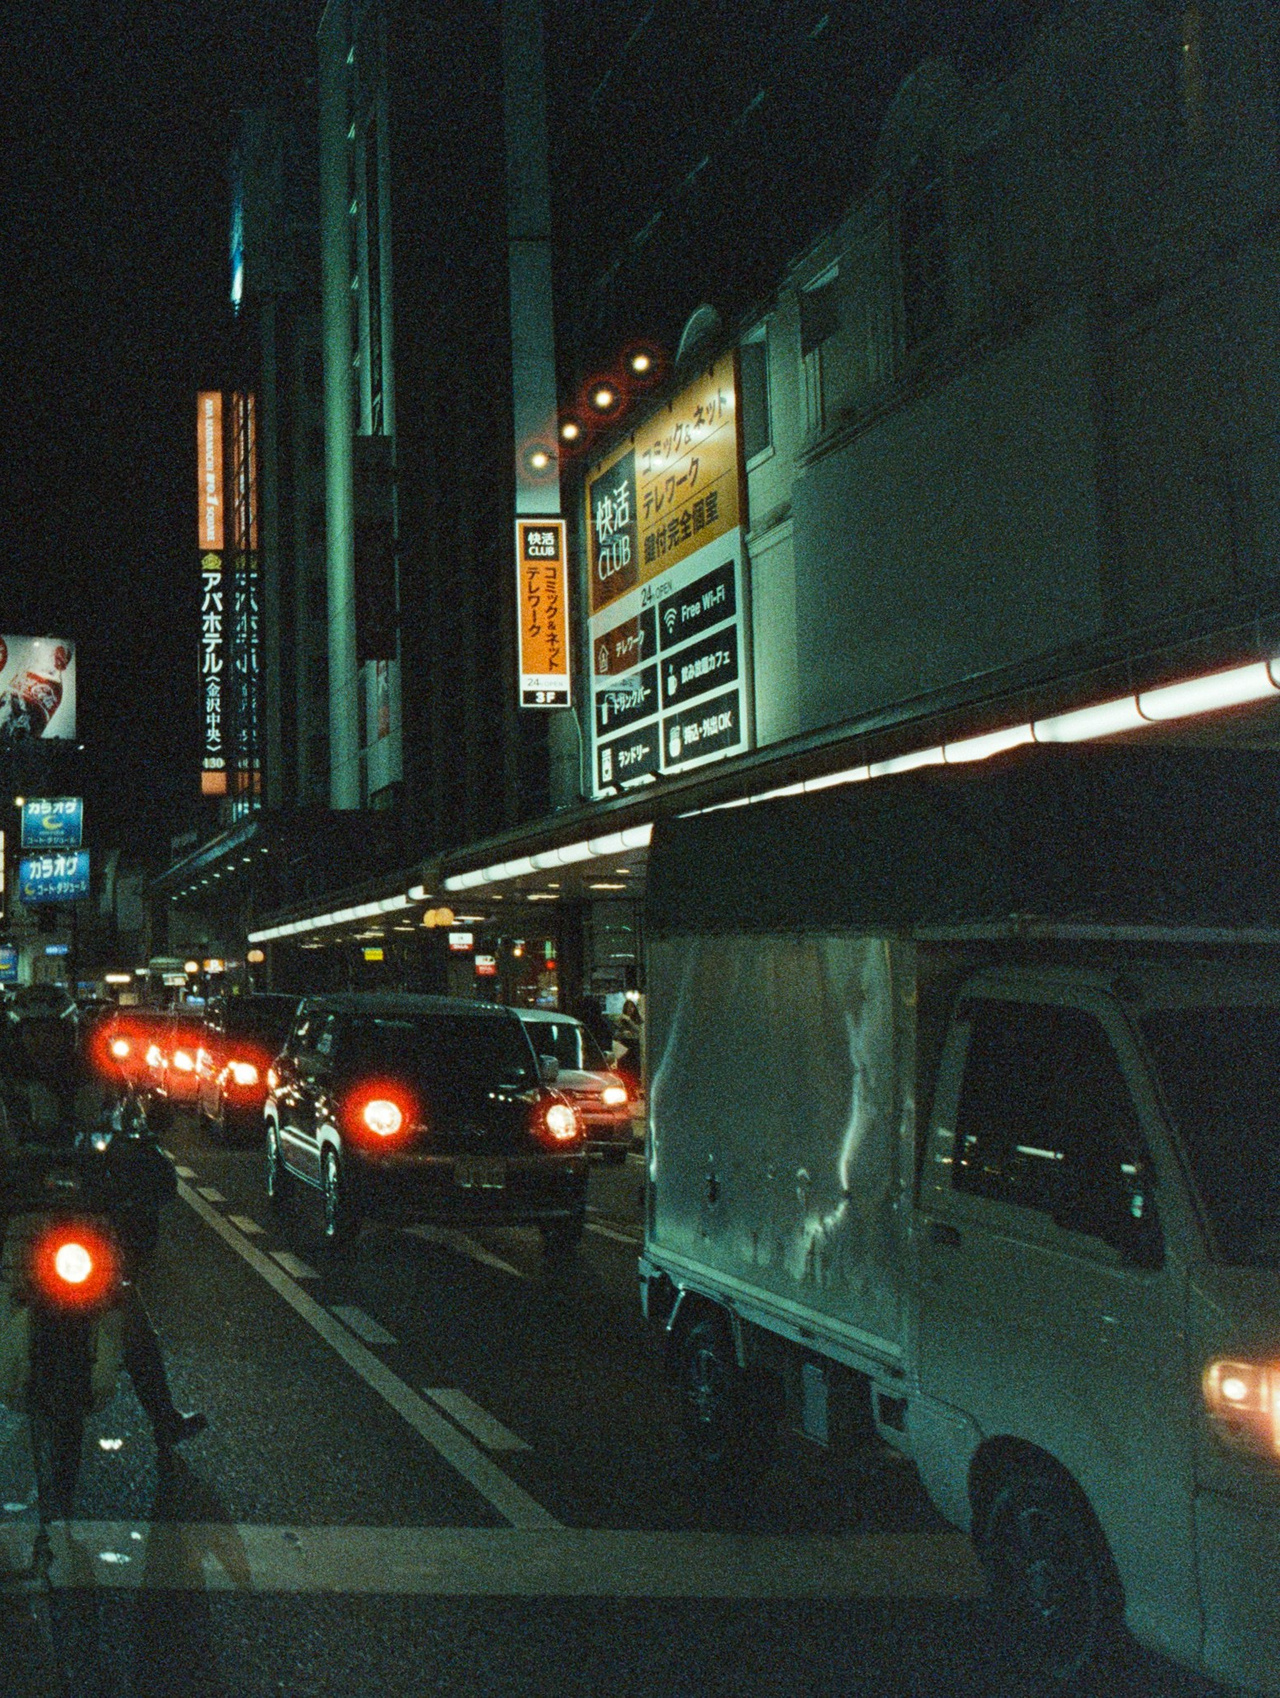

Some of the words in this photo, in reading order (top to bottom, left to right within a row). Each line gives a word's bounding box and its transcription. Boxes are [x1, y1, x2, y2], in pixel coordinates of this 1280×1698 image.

[642, 388, 726, 476] コミック&ネット
[642, 457, 700, 519] テレワーク
[596, 481, 630, 544] 快活
[643, 491, 719, 565] 鍵付完全個室
[528, 532, 554, 545] 快活
[528, 546, 555, 556] CLUB
[598, 535, 631, 581] CLUB
[527, 566, 541, 637] テレワーク
[681, 604, 701, 622] Free
[702, 584, 726, 609] Wi-Fi
[545, 566, 559, 671] コミック&ネット
[615, 630, 645, 658] テレワーク
[535, 691, 555, 703] 3F
[614, 687, 651, 715] ドリンクバー
[618, 745, 650, 768] ランドリー
[28, 801, 77, 815] カラオケ
[30, 856, 78, 879] カラオケ
